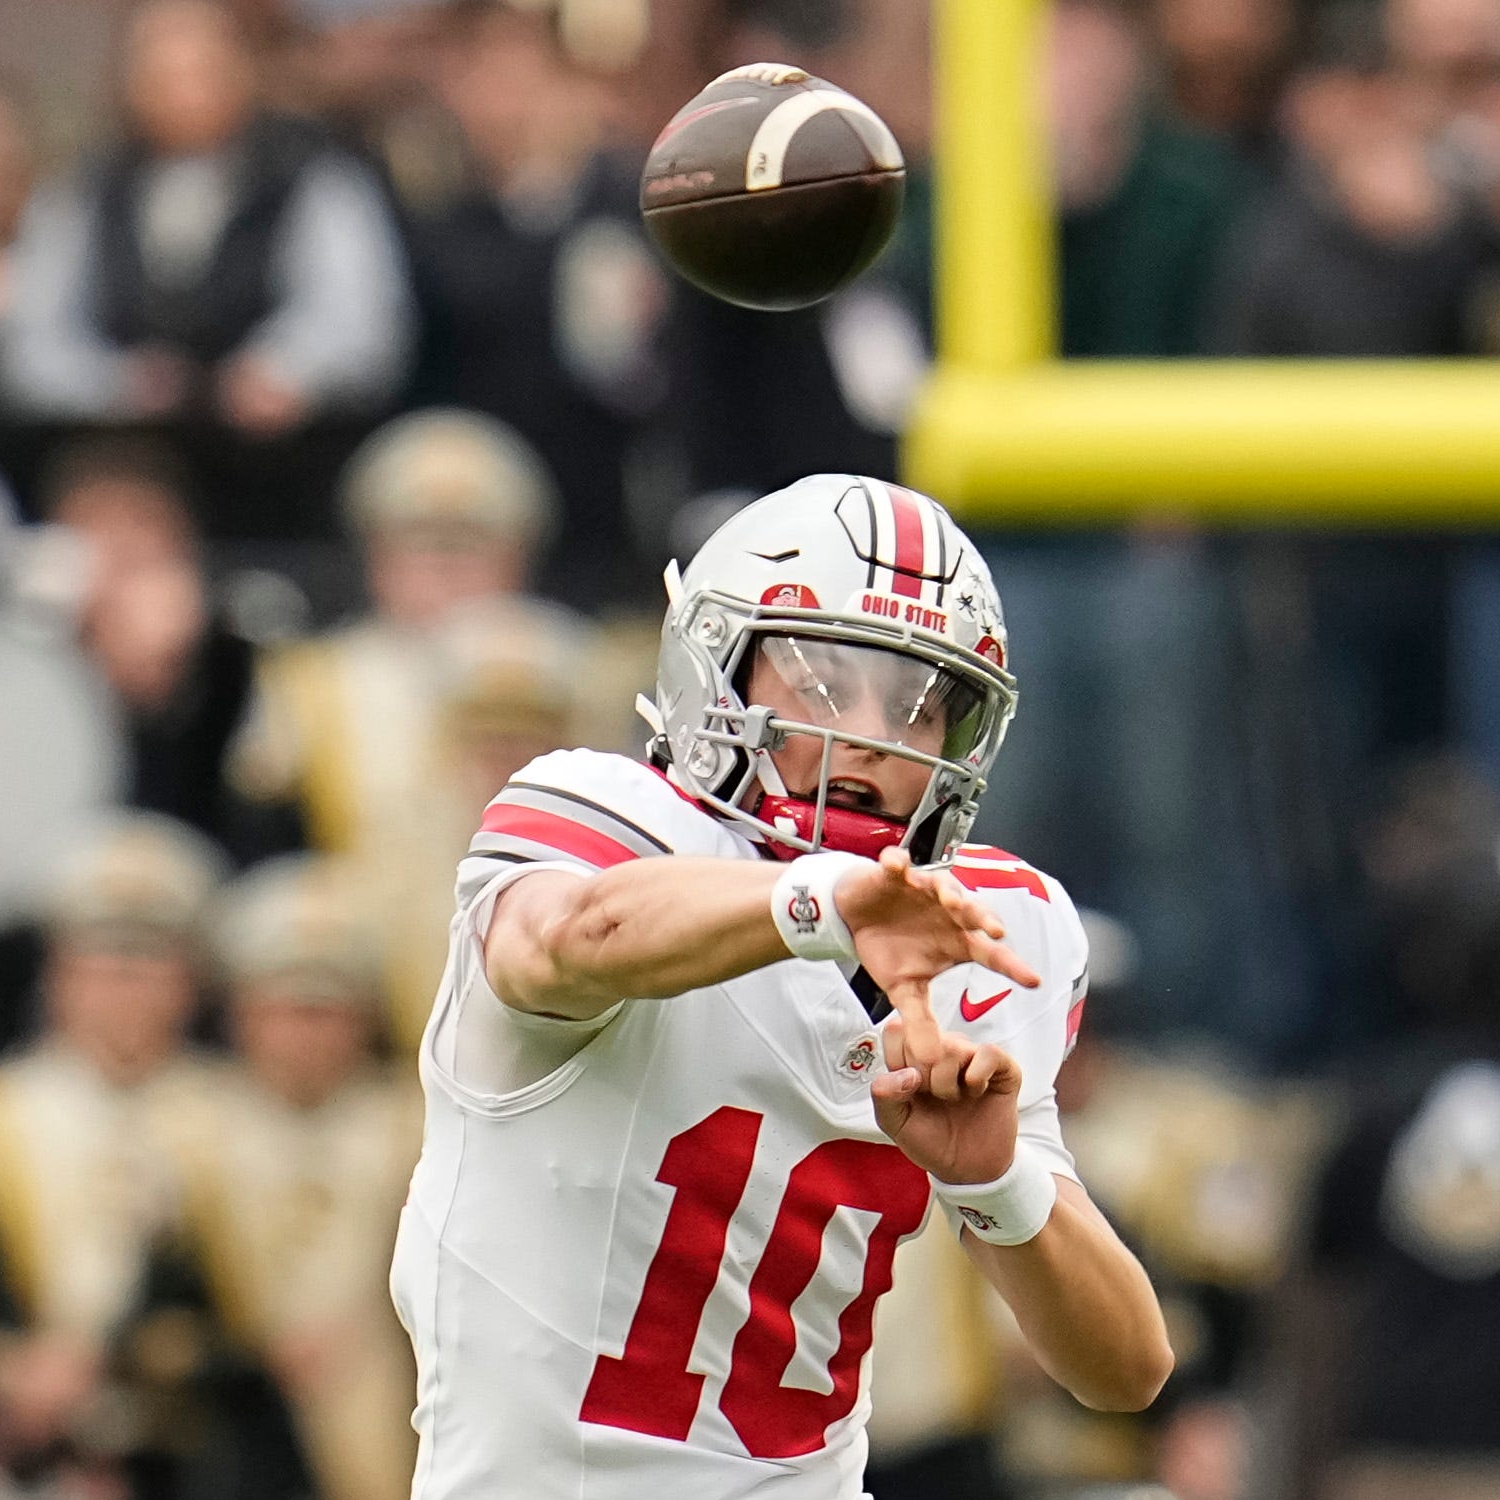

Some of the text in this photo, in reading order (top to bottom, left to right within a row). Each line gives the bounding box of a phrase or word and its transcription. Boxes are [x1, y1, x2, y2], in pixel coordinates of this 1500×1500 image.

[862, 594, 947, 634] OHIO STATE
[578, 1105, 931, 1458] 10
